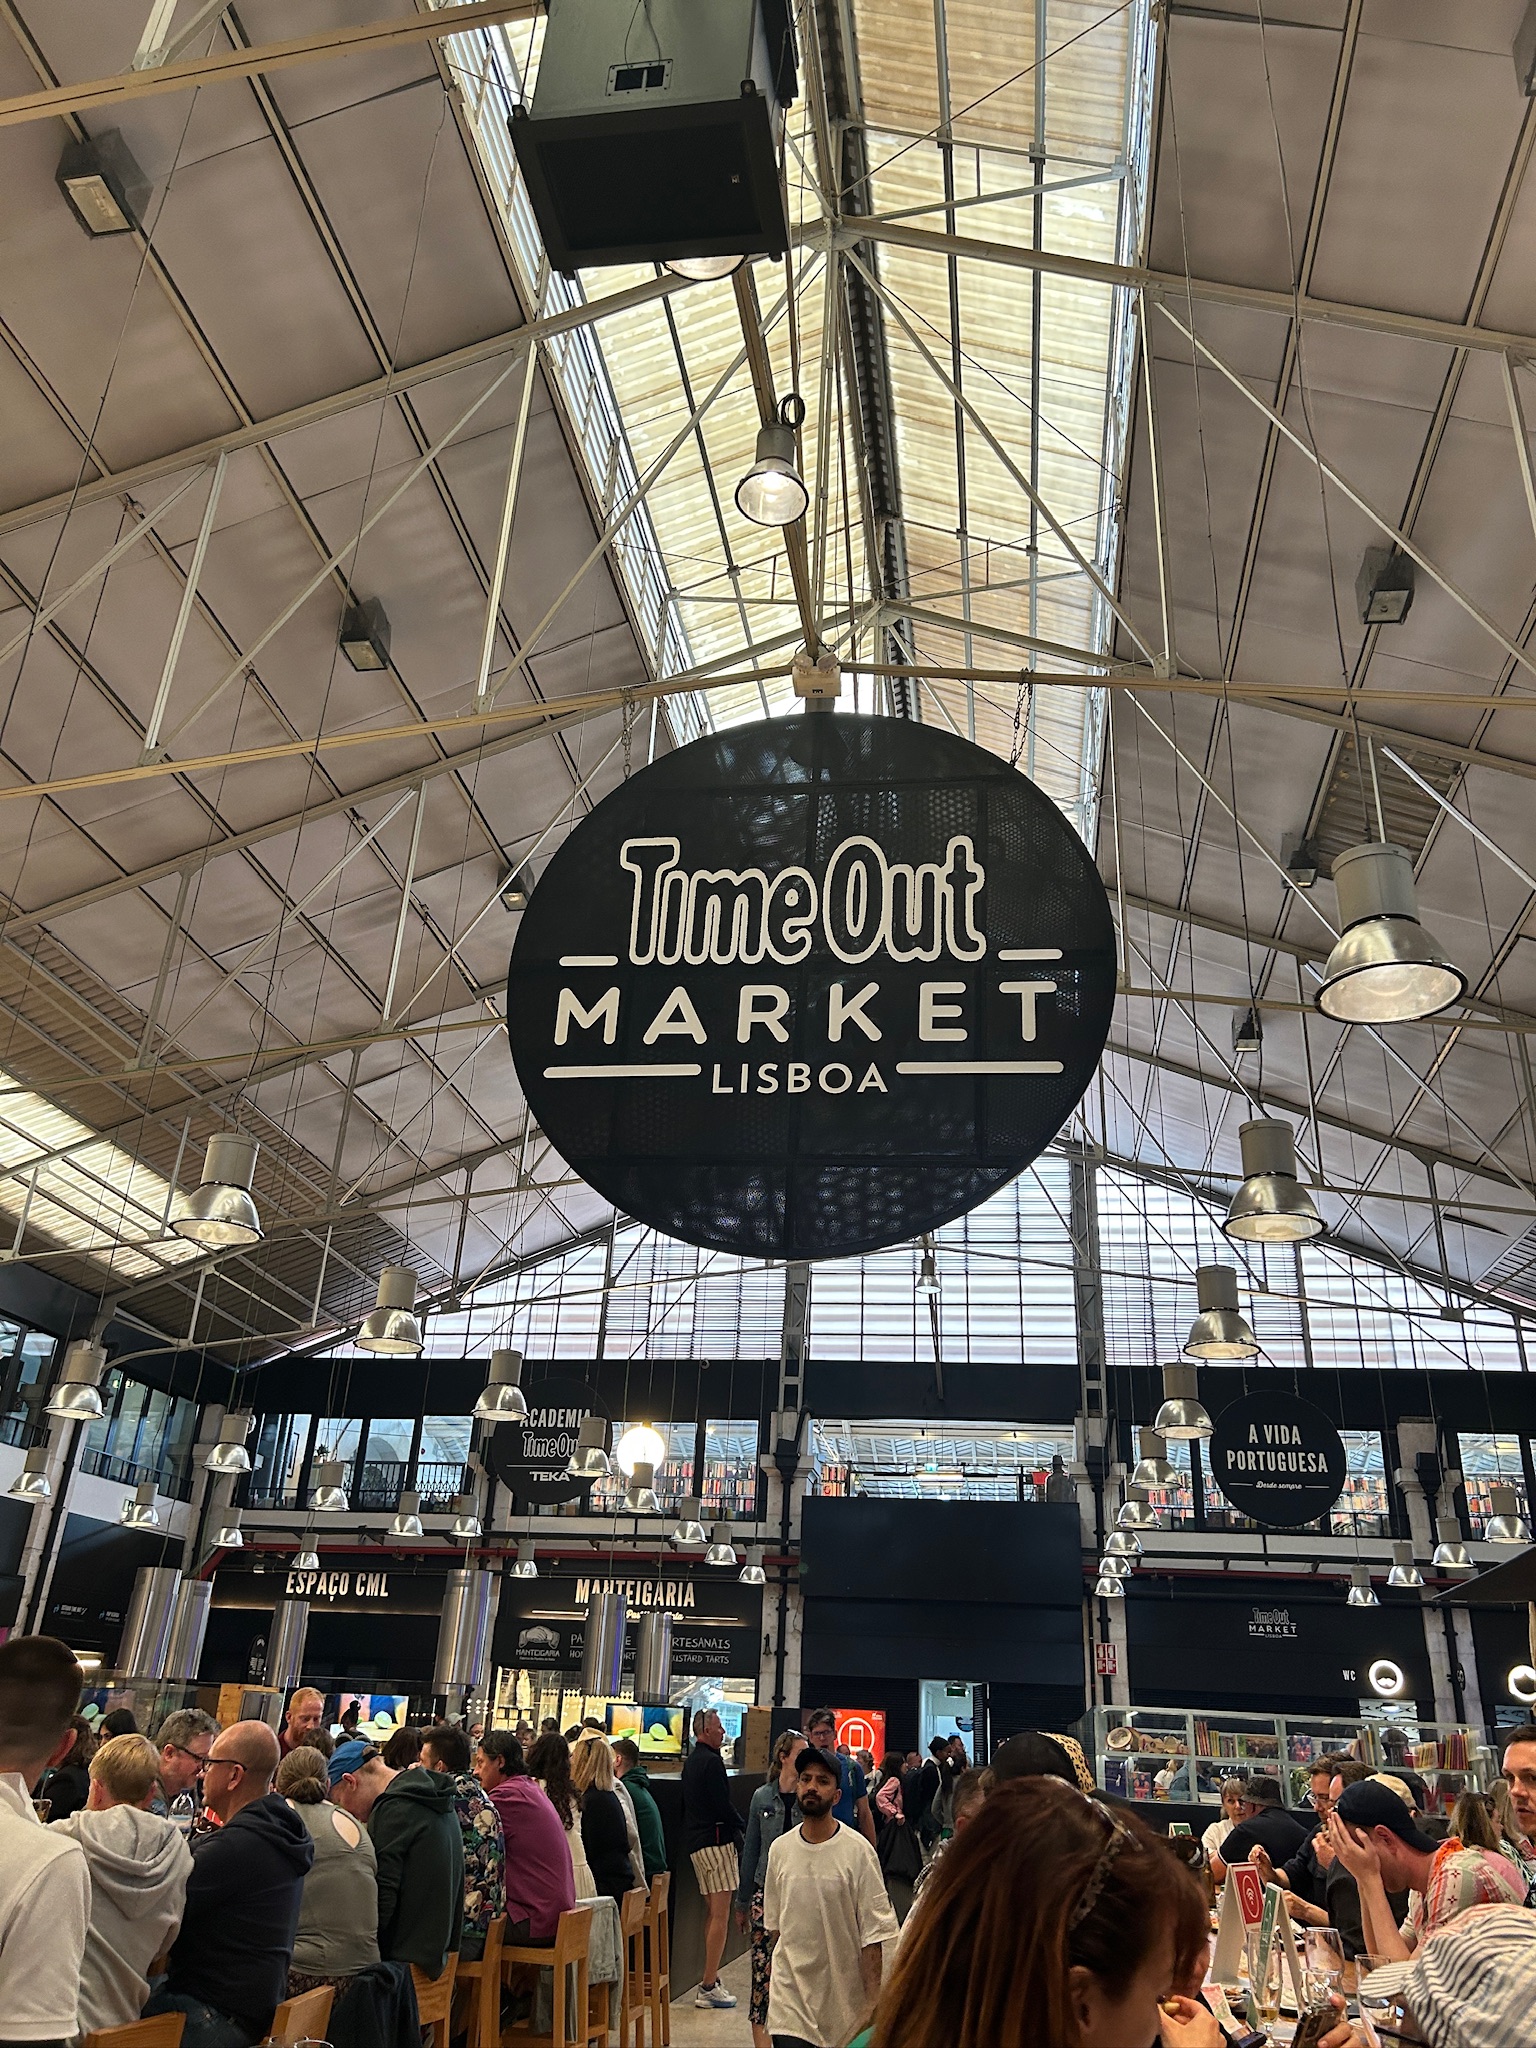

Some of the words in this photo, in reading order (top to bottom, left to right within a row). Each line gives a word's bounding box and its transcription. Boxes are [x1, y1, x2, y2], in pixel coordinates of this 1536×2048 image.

[554, 981, 1058, 1045] MARKET
[712, 1062, 888, 1094] LISBOA
[1248, 1424, 1259, 1444] A
[1263, 1424, 1302, 1445] VIDA
[1226, 1450, 1328, 1473] PORTUGUESA
[529, 1471, 570, 1481] TEKA
[1255, 1480, 1277, 1489] Desde
[1278, 1482, 1303, 1491] sempre
[286, 1571, 349, 1602] ESPAÇO
[355, 1573, 389, 1597] CML
[575, 1579, 695, 1607] MANTEIGARIA
[1248, 1624, 1297, 1634] MARKET
[672, 1637, 731, 1649] RTESANAIS
[672, 1653, 703, 1663] USTARD
[706, 1655, 730, 1665] TARTS
[1342, 1669, 1356, 1681] WC
